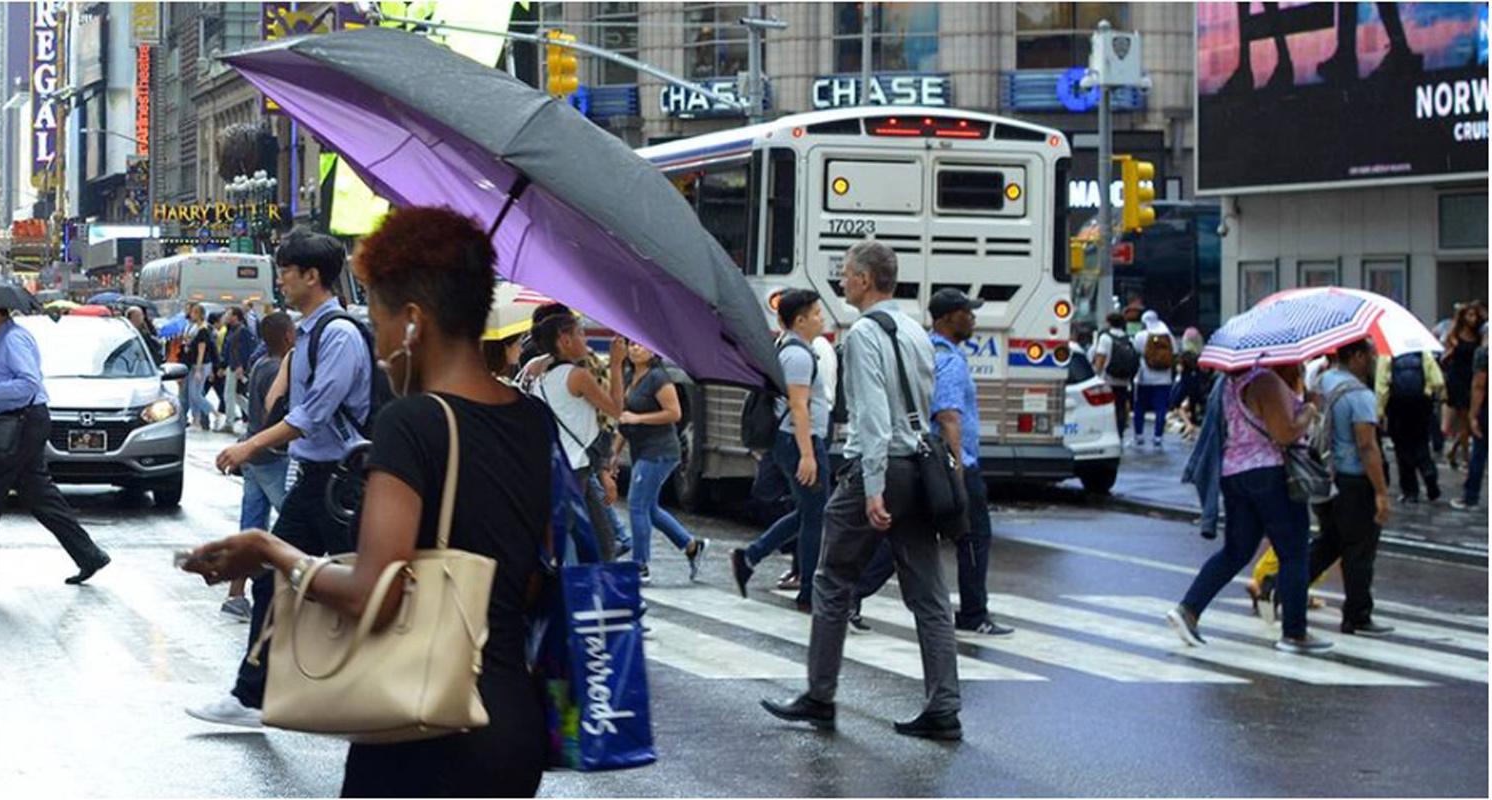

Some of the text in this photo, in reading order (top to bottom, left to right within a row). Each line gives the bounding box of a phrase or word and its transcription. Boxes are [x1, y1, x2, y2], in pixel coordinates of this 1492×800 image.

[34, 2, 57, 162] REGAL
[659, 79, 751, 113] CHAS
[812, 76, 945, 107] CHASE
[1416, 78, 1489, 119] NORW
[1454, 121, 1489, 141] CRUI
[153, 201, 282, 223] HARRY POTR
[829, 219, 876, 234] 17023
[572, 594, 635, 737] Harrods
